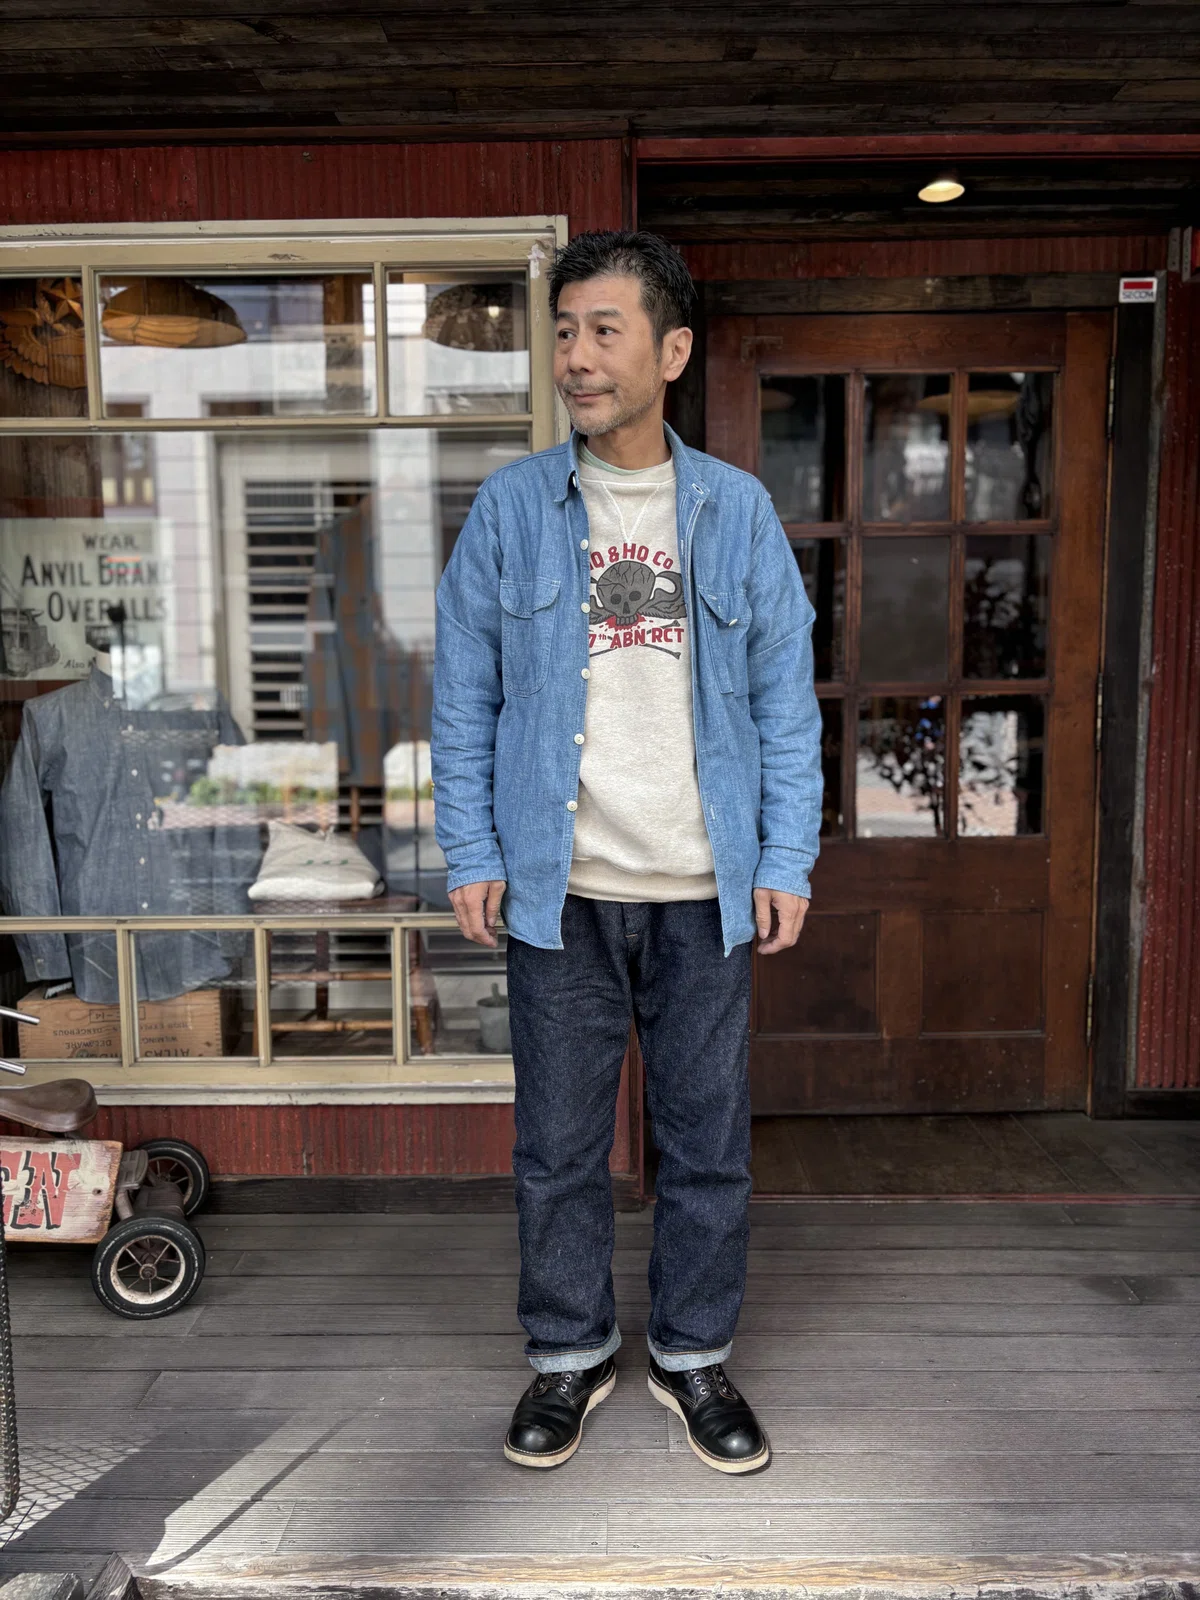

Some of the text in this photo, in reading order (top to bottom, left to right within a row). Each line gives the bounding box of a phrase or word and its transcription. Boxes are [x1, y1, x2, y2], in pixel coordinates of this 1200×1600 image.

[22, 554, 91, 587] ANVIL
[590, 551, 605, 571] Q
[608, 546, 619, 563] &
[610, 629, 646, 649] ABN
[651, 628, 685, 643] RCT
